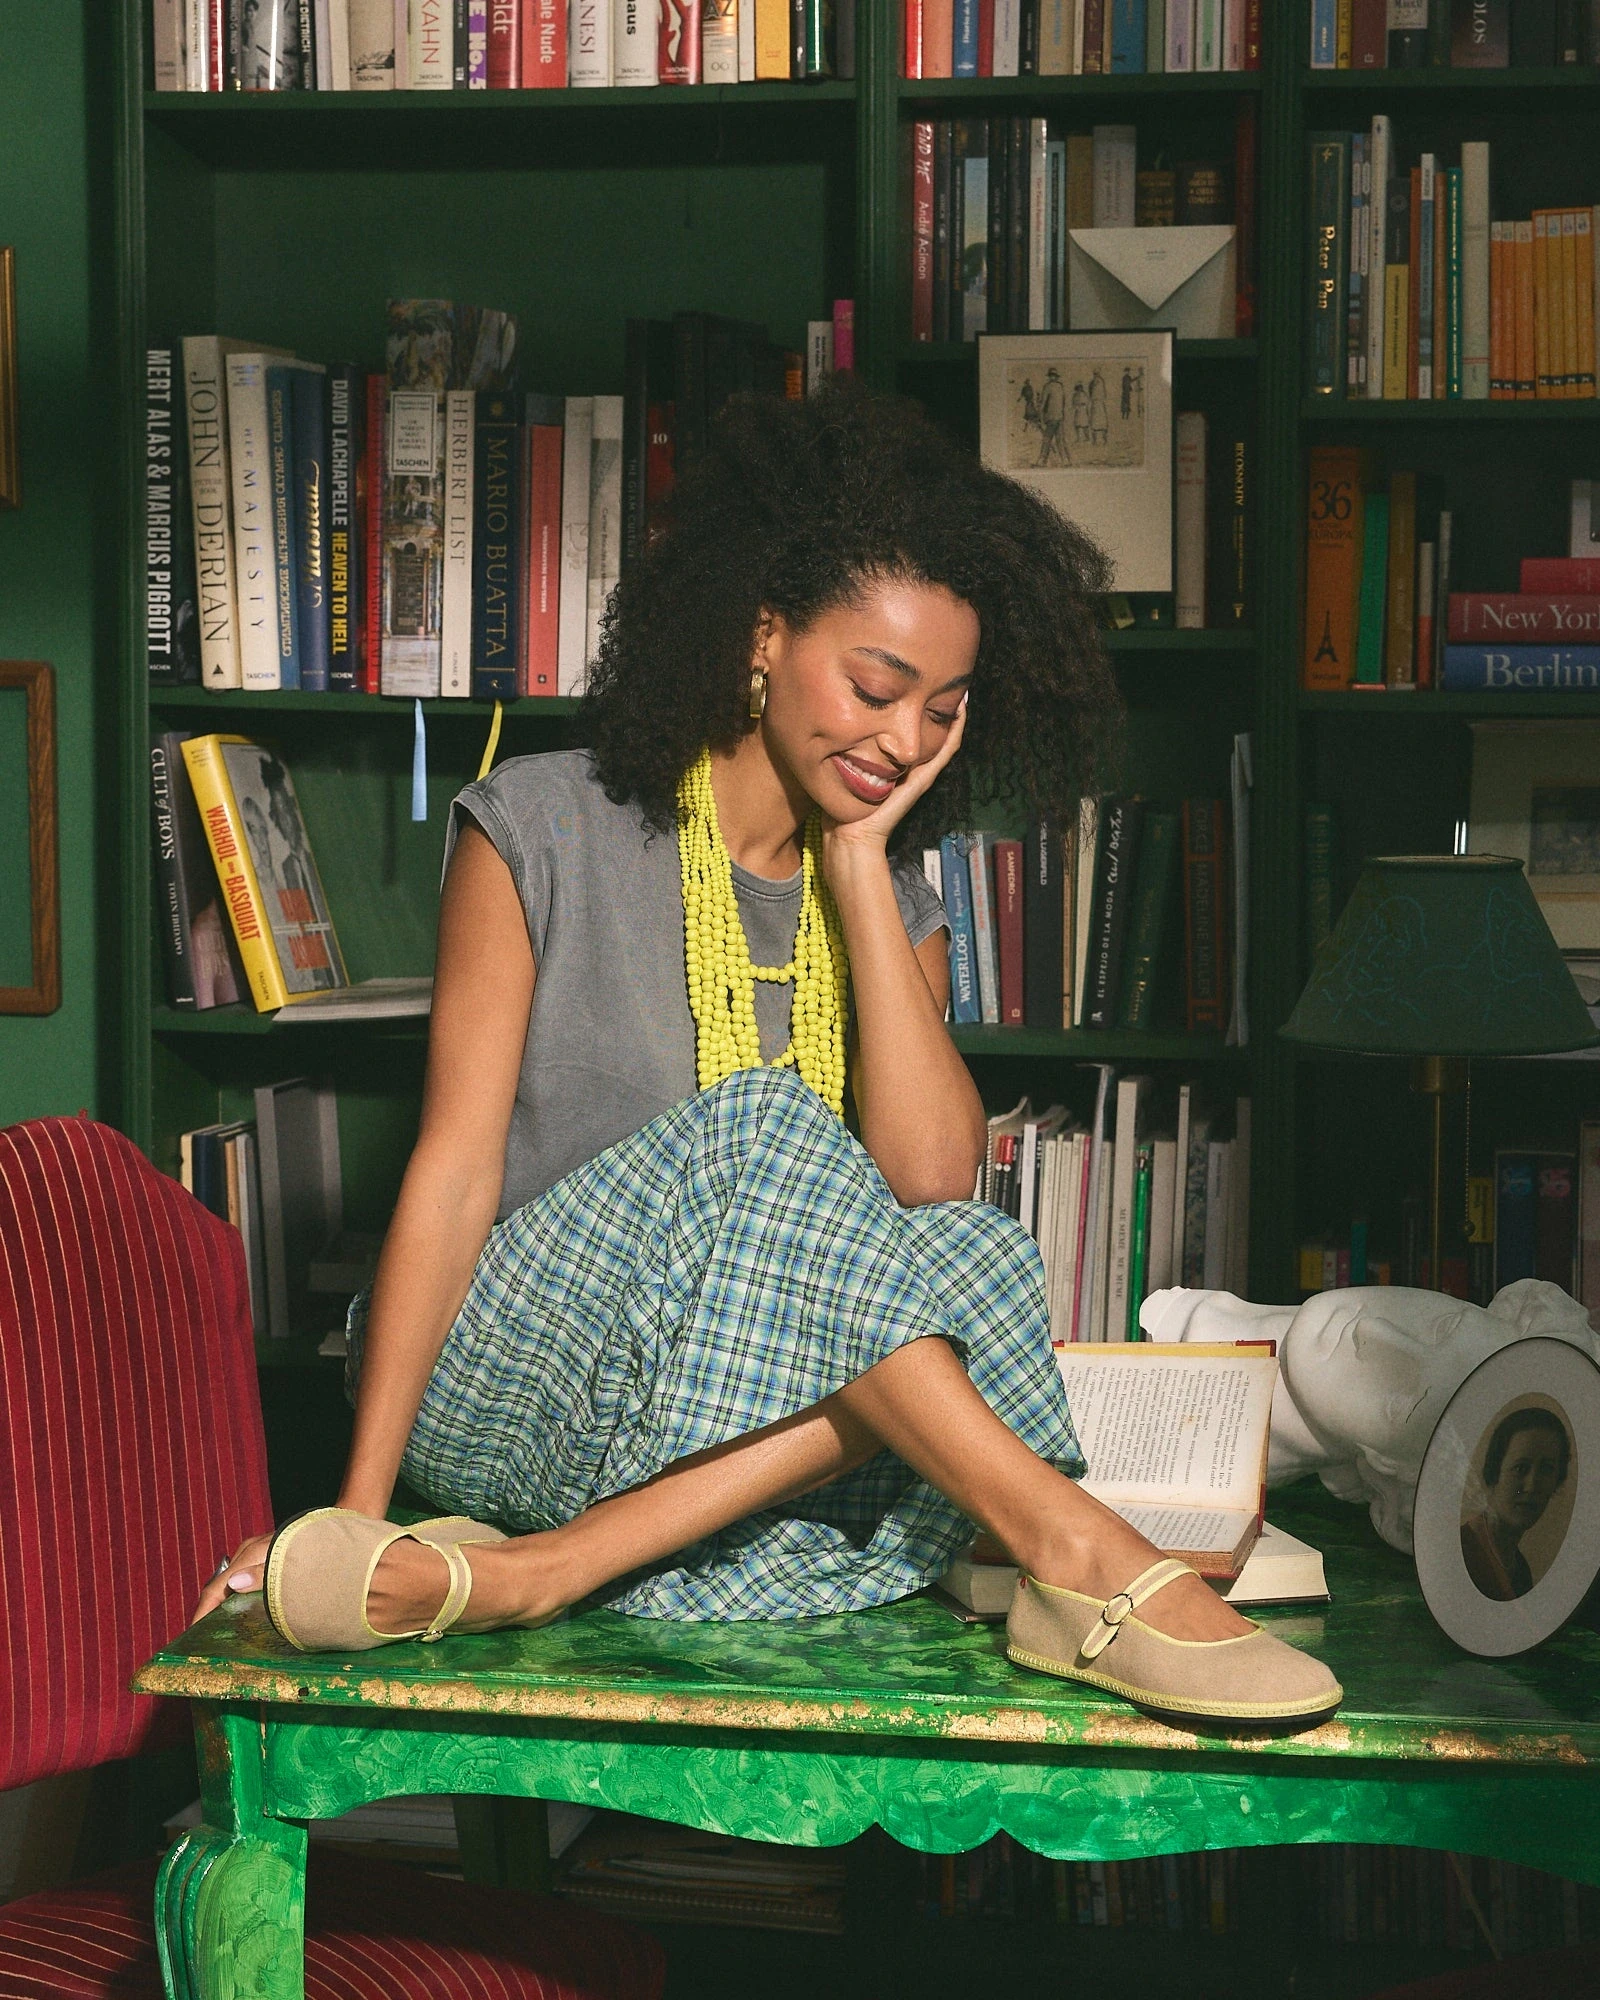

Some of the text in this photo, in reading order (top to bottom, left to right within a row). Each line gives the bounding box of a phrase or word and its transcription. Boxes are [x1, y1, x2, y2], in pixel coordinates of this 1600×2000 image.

[300, 7, 311, 53] DIETRICH
[540, 24, 556, 64] Nude
[916, 160, 931, 185] ME
[918, 201, 930, 280] André Aciman
[1318, 225, 1336, 309] Peter Pan
[189, 371, 221, 468] JOHN
[651, 433, 668, 444] 10
[395, 458, 429, 468] TASCHEN
[450, 399, 468, 565] HERBERT LIST
[1235, 459, 1245, 506] ALFONSO
[147, 349, 171, 655] MERT ALAS & MARCUS PIGGOTT
[331, 379, 348, 655] DAVID LACHAPELLE HEAVEN TO HELL
[1311, 481, 1352, 521] 36
[242, 468, 265, 631] MAJESTY
[486, 437, 508, 658] MARIO BUATTA
[197, 501, 230, 643] DERIAN
[1482, 603, 1600, 630] New Yor
[246, 670, 277, 680] TASCHEN
[1483, 653, 1599, 687] Berlin
[151, 748, 170, 800] CULT
[157, 815, 175, 860] BOYS
[206, 803, 238, 863] WARHOL
[225, 874, 261, 942] BASQUIAT
[1006, 851, 1016, 895] SAMPEDRO
[1104, 890, 1114, 919] MODA
[1102, 936, 1110, 949] DE
[1103, 922, 1112, 934] LA
[955, 933, 972, 1003] WATERLOG
[1099, 952, 1109, 985] ESPEJO
